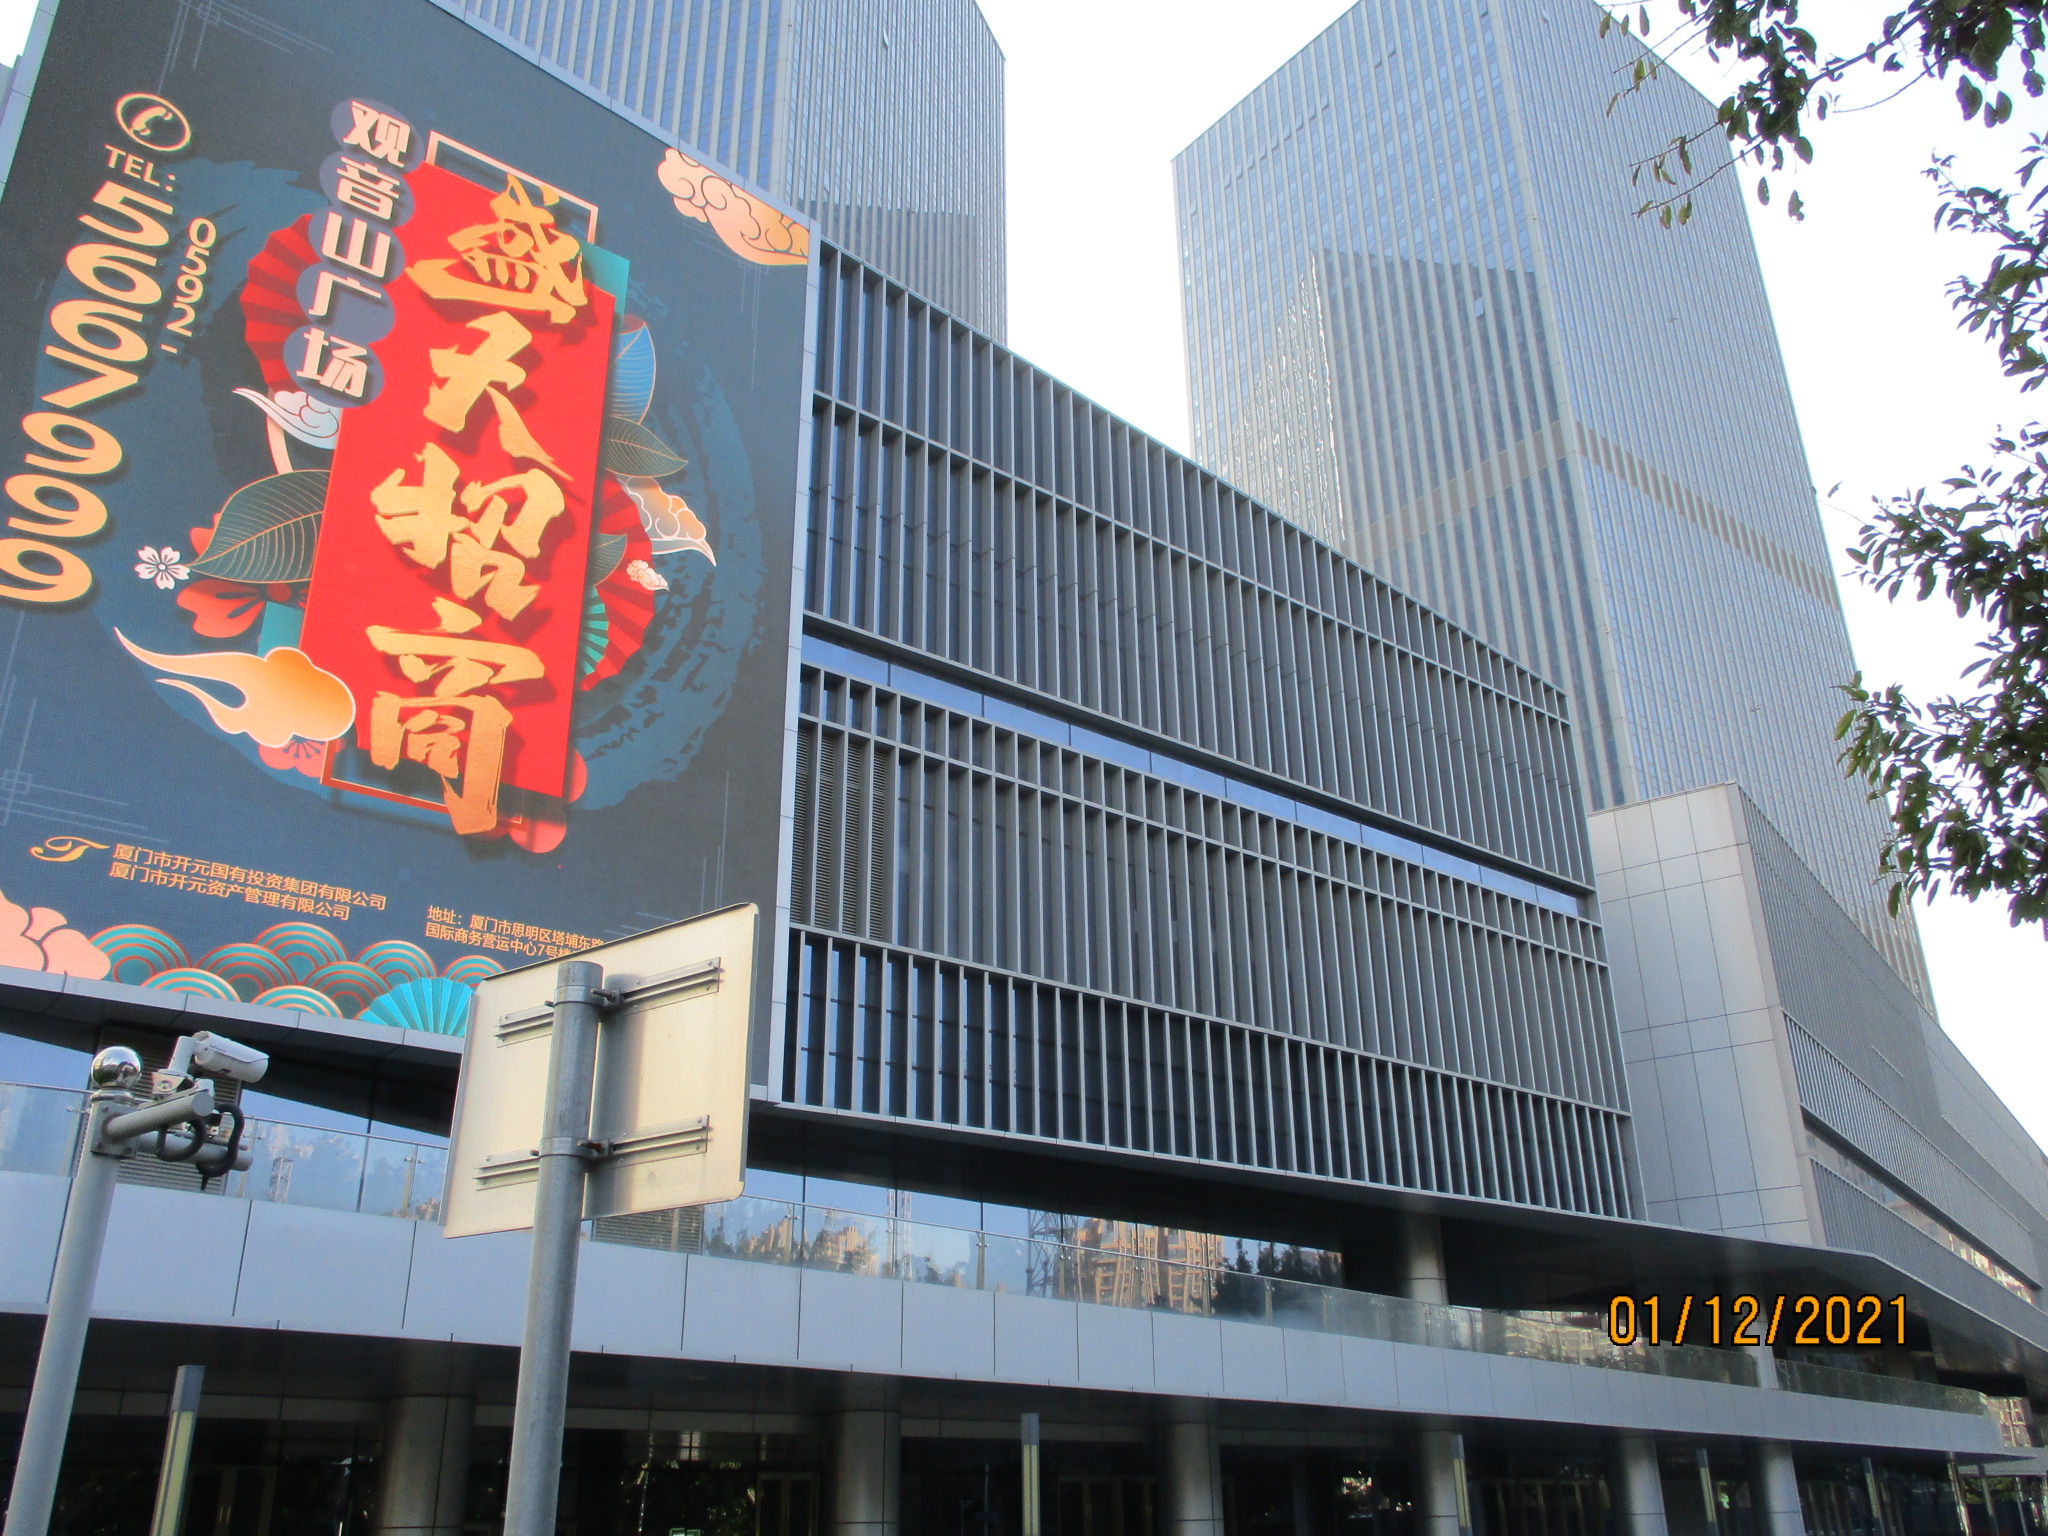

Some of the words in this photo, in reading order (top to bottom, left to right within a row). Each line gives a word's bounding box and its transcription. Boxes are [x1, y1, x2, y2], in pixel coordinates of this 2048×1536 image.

[105, 145, 177, 192] TEL:
[296, 100, 410, 400] 观音山广场
[0, 181, 174, 604] 5667999
[366, 172, 588, 835] 盛大招商
[108, 861, 351, 921] 厦门市开元资产管理有限公司
[112, 843, 387, 911] 厦门市开元国有投资集团有限公司
